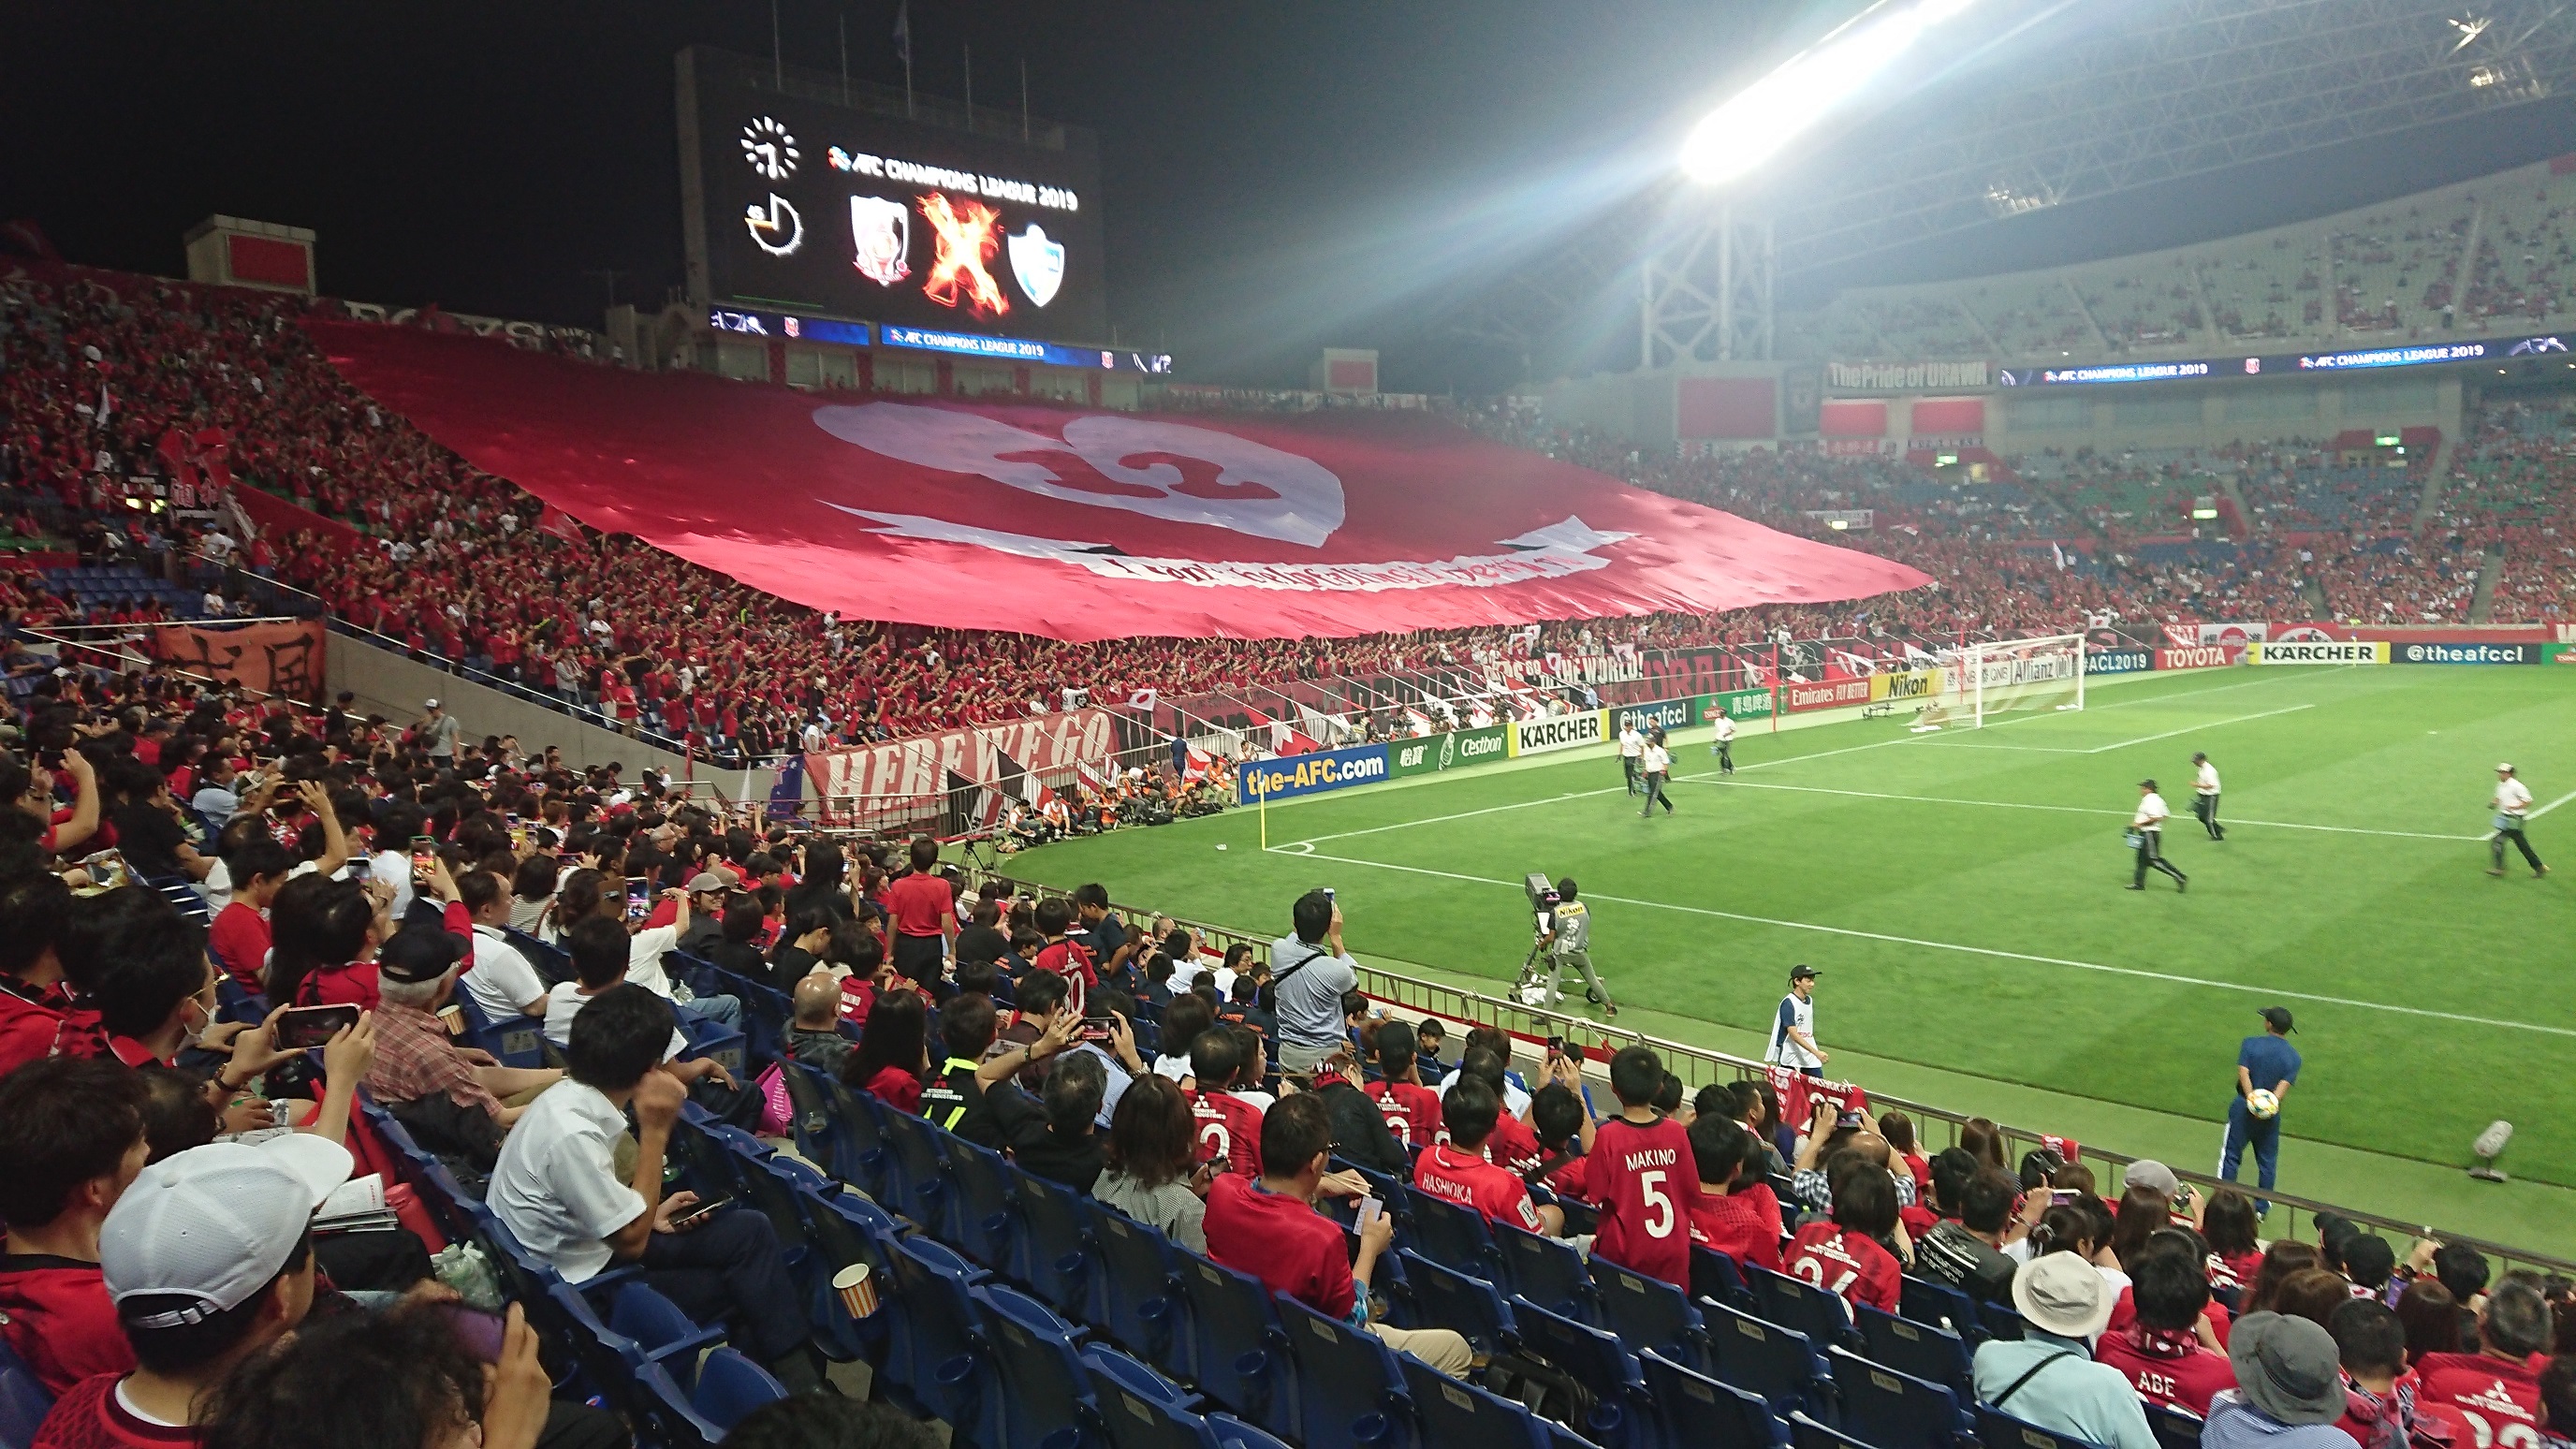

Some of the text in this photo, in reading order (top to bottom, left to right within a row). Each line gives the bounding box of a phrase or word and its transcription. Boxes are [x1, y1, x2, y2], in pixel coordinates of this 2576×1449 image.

[886, 158, 978, 194] CHAMPIONS
[979, 174, 1037, 204] LEAGUE
[1038, 183, 1077, 212] 2019
[923, 332, 979, 352] CHAMPIONS
[980, 338, 1017, 355] LEAGUE
[1018, 343, 1044, 357] 2019
[2336, 351, 2402, 366] CHAMPIONS
[2404, 346, 2450, 362] LEAGUE
[2451, 344, 2484, 359] 2019
[2077, 367, 2136, 381] CHAMPIONS
[2137, 365, 2177, 378] LEAGUE
[2179, 363, 2209, 375] 2019
[2163, 647, 2226, 668] TOYOTA
[2263, 645, 2374, 661] KÄRCHER
[2407, 644, 2524, 663] @theafccl
[2014, 660, 2053, 681] Allianz
[1792, 687, 1834, 707] Emirates
[1847, 681, 1868, 698] BETTER
[1888, 675, 1928, 697] Nikon
[1050, 711, 1111, 768] GO
[1520, 716, 1599, 749] KÄRCHER
[1559, 906, 1584, 916] Nikon
[1625, 1149, 1676, 1172] MAKINO
[1422, 1171, 1472, 1205] HASHIOKA
[1641, 1170, 1675, 1238] 5
[2138, 1370, 2176, 1398] ABE
